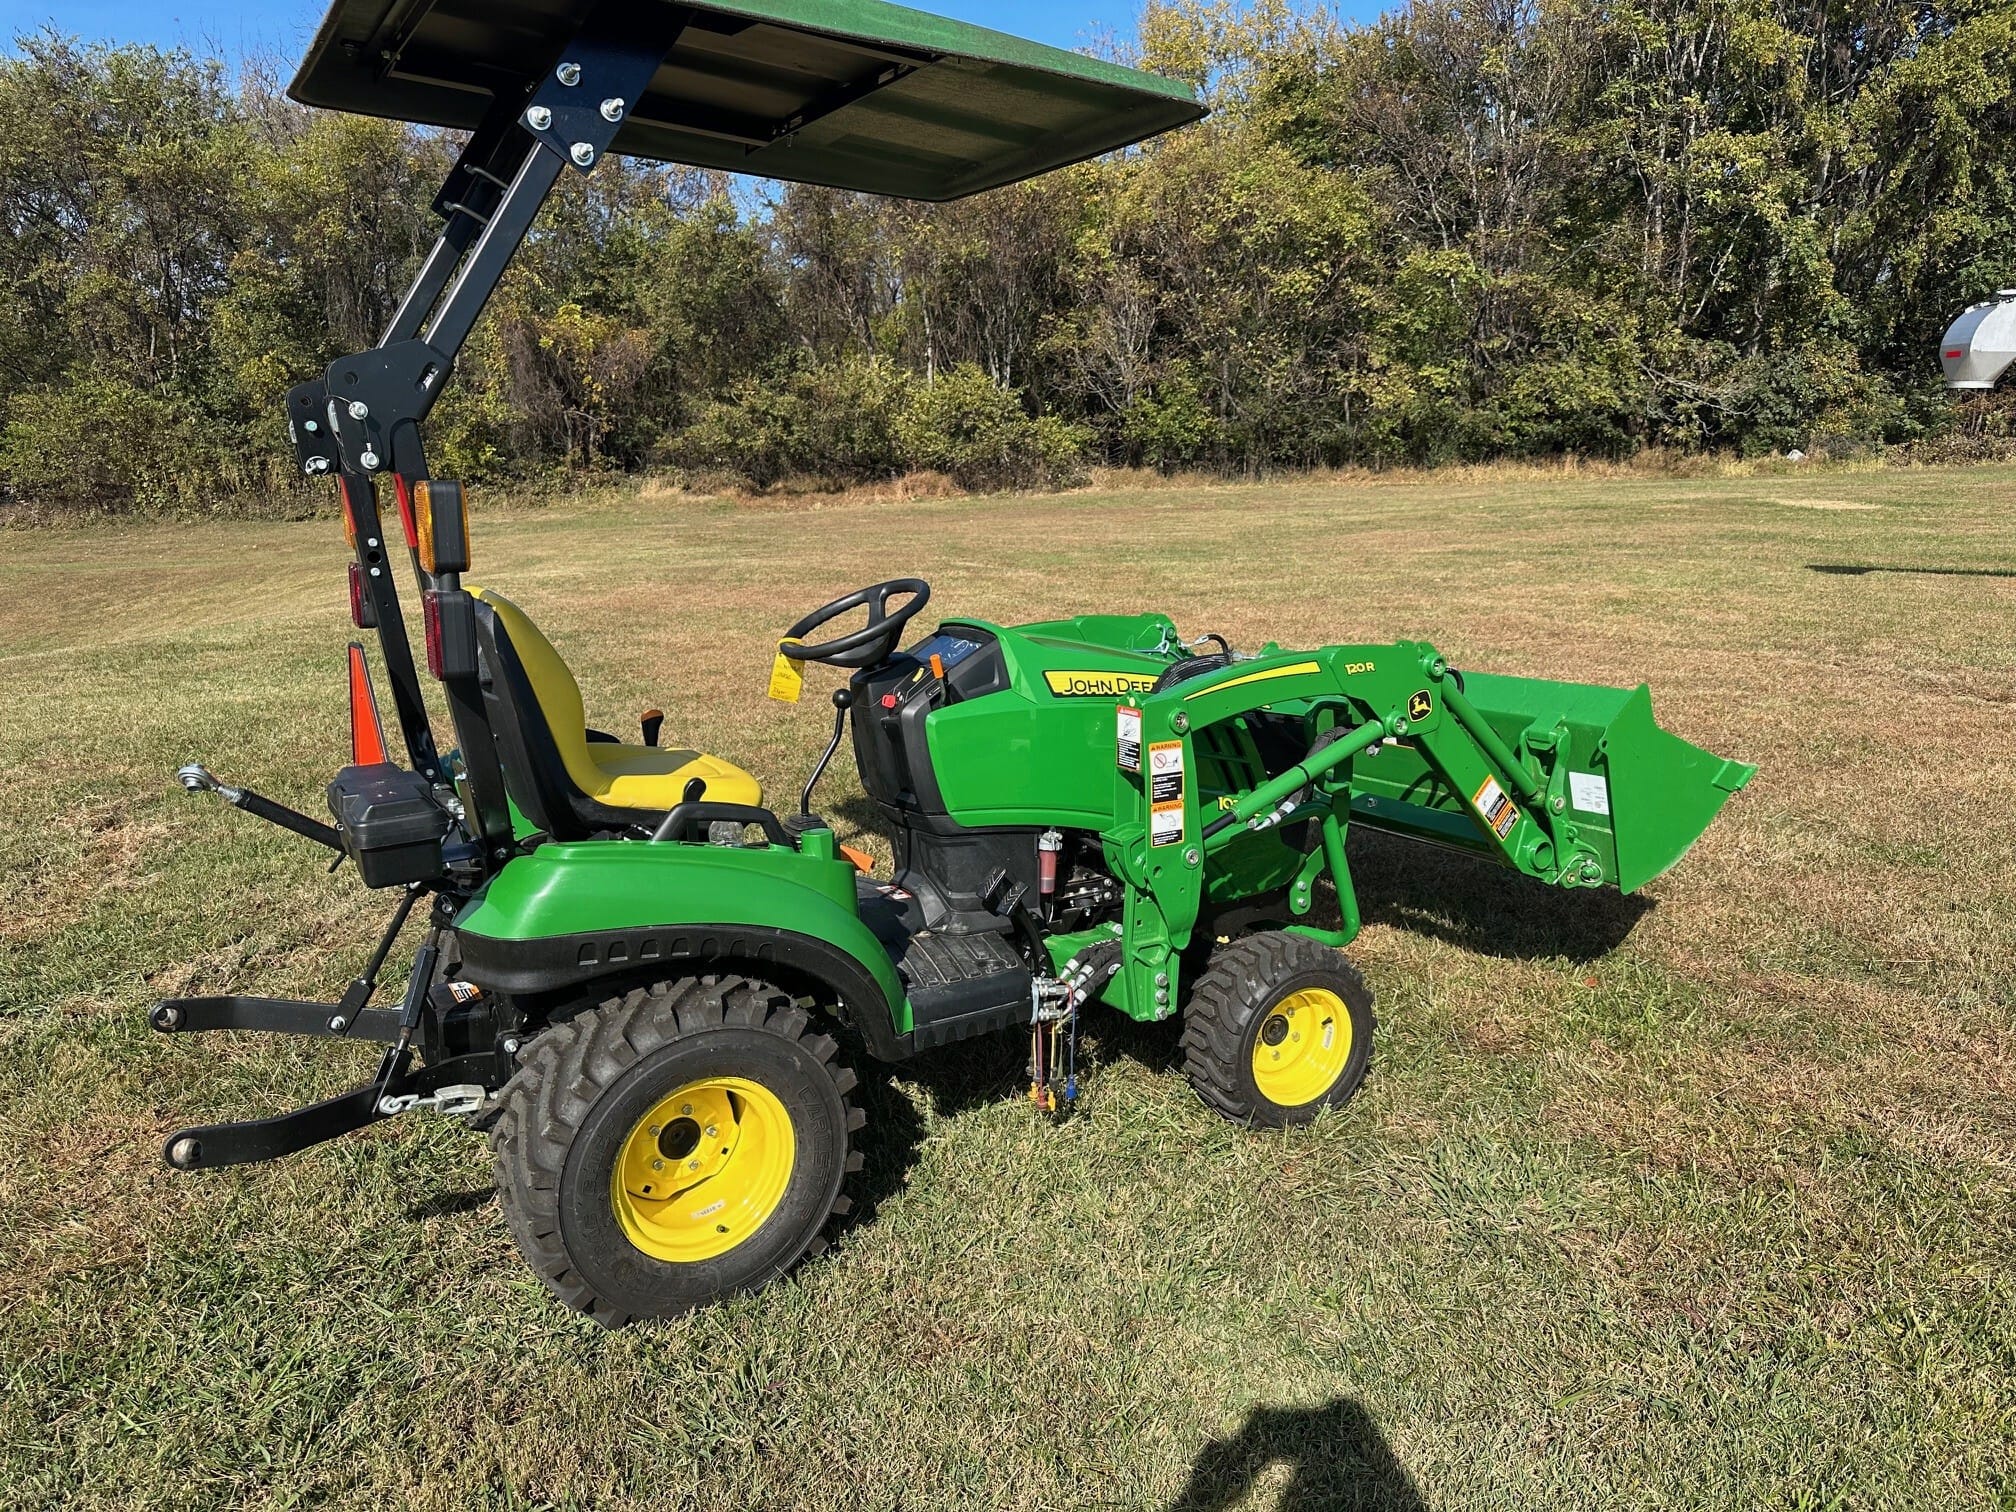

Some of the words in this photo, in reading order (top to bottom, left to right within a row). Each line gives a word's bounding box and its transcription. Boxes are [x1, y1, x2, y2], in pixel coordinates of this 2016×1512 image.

[1344, 661, 1376, 676] 120R
[1064, 677, 1113, 694] JOHN
[1116, 678, 1158, 694] DEE
